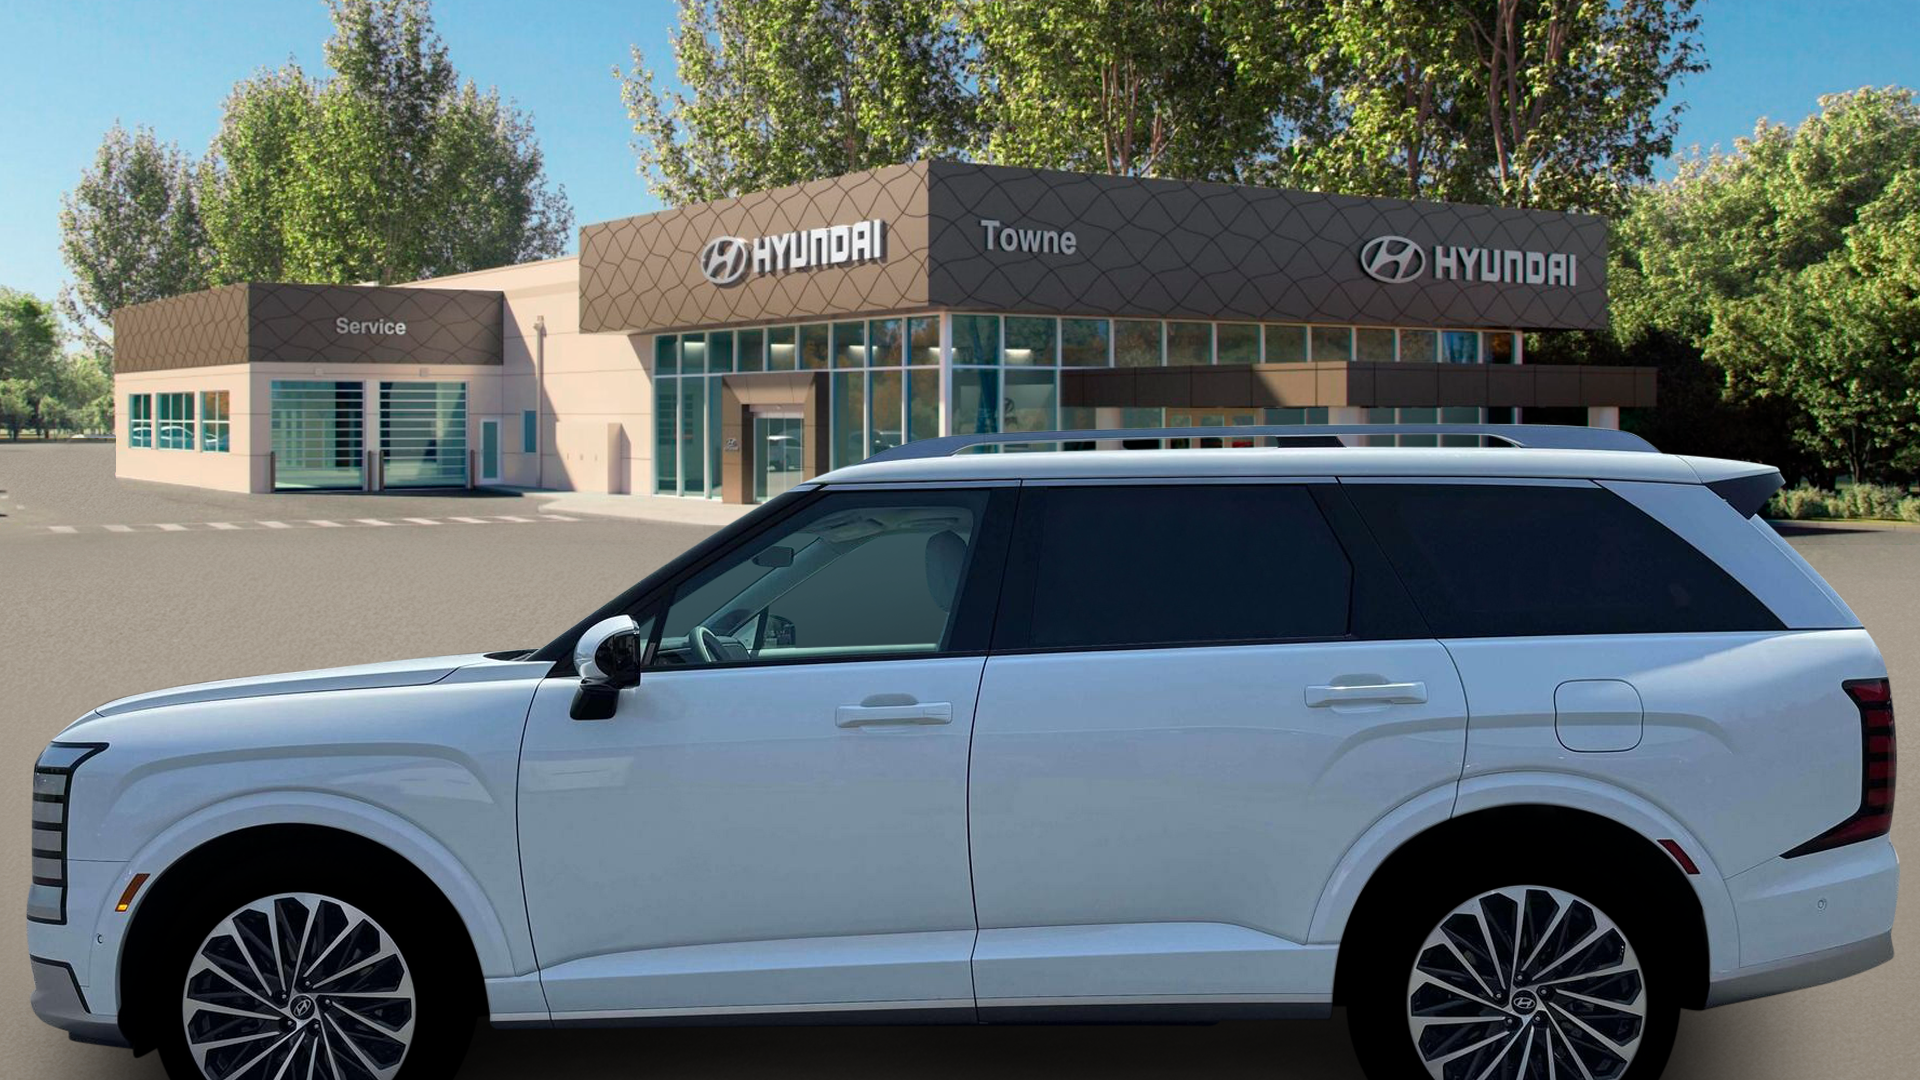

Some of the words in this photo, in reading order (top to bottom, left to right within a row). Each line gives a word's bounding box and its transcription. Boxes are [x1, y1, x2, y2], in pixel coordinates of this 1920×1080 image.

[753, 219, 882, 274] HYUNDAI
[980, 219, 1077, 255] Towne
[1435, 245, 1577, 287] HYUNDAI
[335, 317, 407, 335] Service
